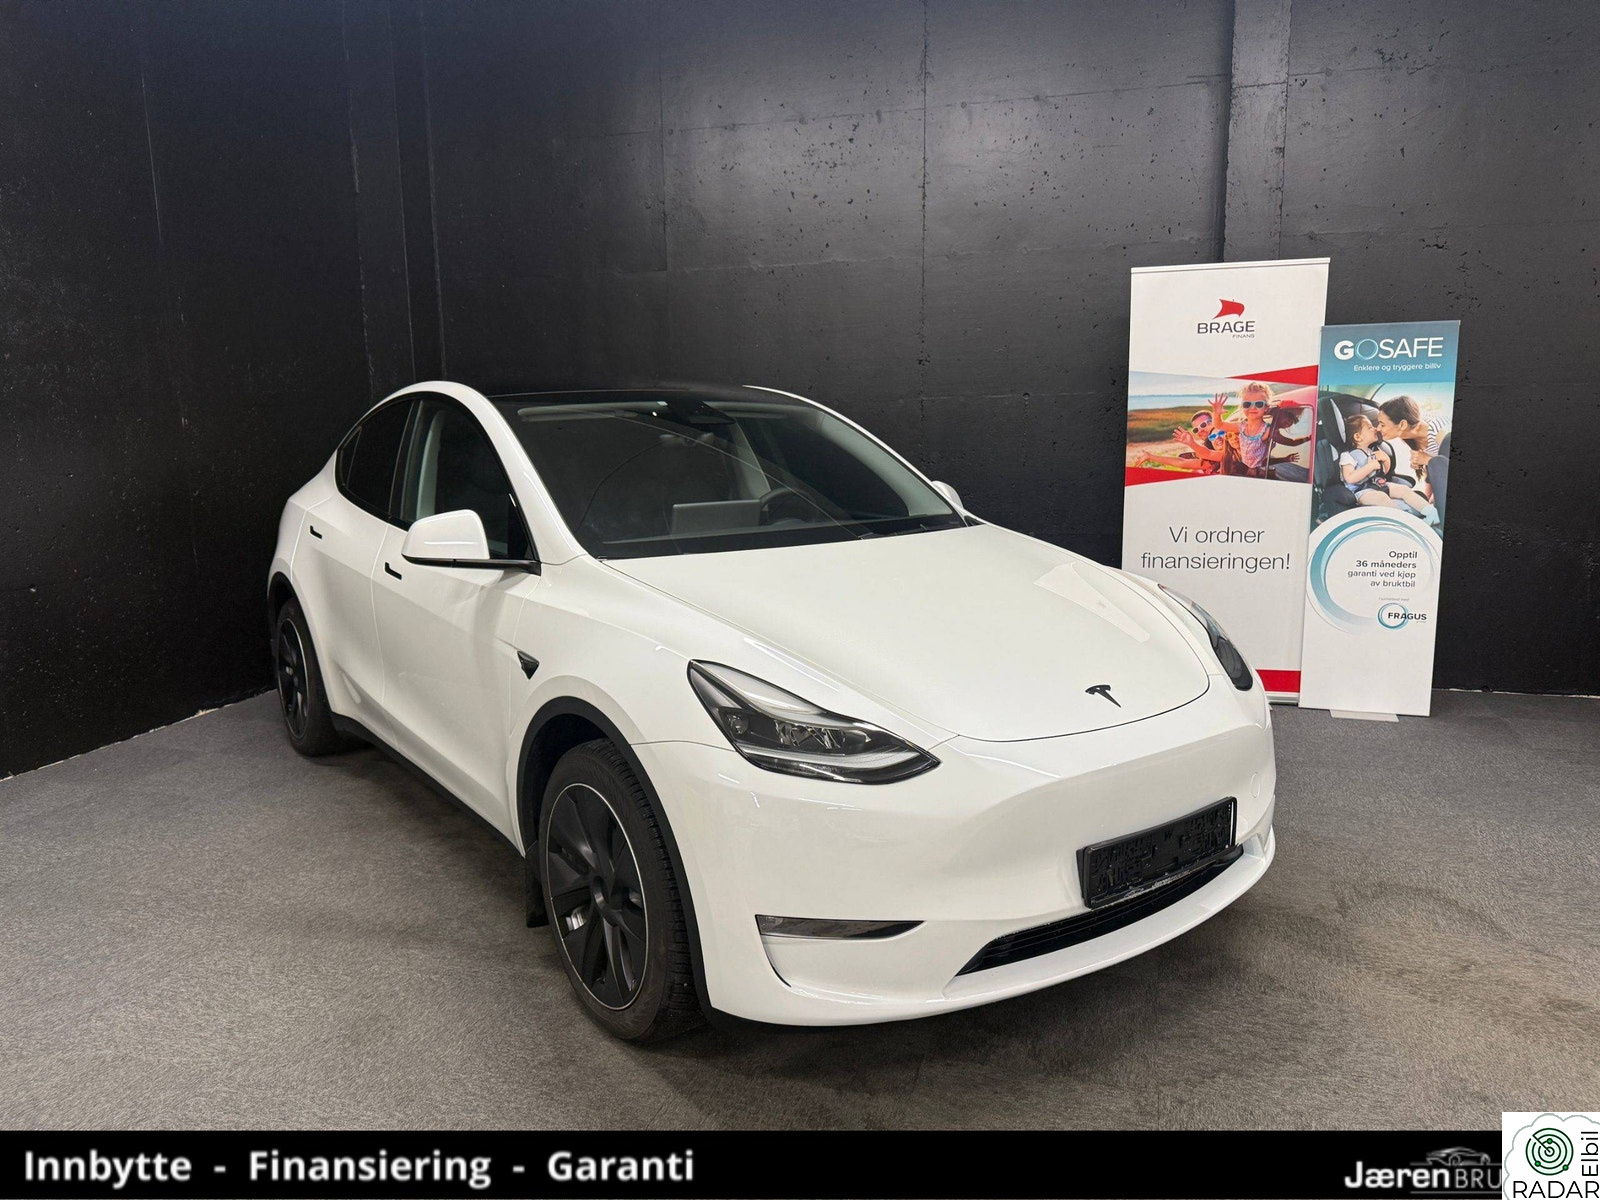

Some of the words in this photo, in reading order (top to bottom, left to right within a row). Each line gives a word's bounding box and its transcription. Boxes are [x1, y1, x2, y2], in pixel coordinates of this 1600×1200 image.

[1197, 320, 1256, 334] BRAGE
[1334, 336, 1444, 361] GOSAFE
[1353, 364, 1380, 372] Enklere
[1392, 363, 1423, 372] tryggere
[1169, 526, 1188, 543] Vi
[1195, 526, 1265, 544] ordner
[1388, 550, 1418, 560] Opptil
[1141, 552, 1291, 574] finansieringen!
[1355, 560, 1368, 568] 36
[1370, 560, 1417, 569] måneders
[1347, 570, 1377, 578] garanti
[1397, 571, 1416, 579] kjøp
[1382, 580, 1416, 588] bruktbil
[1387, 612, 1427, 621] FRAGUS
